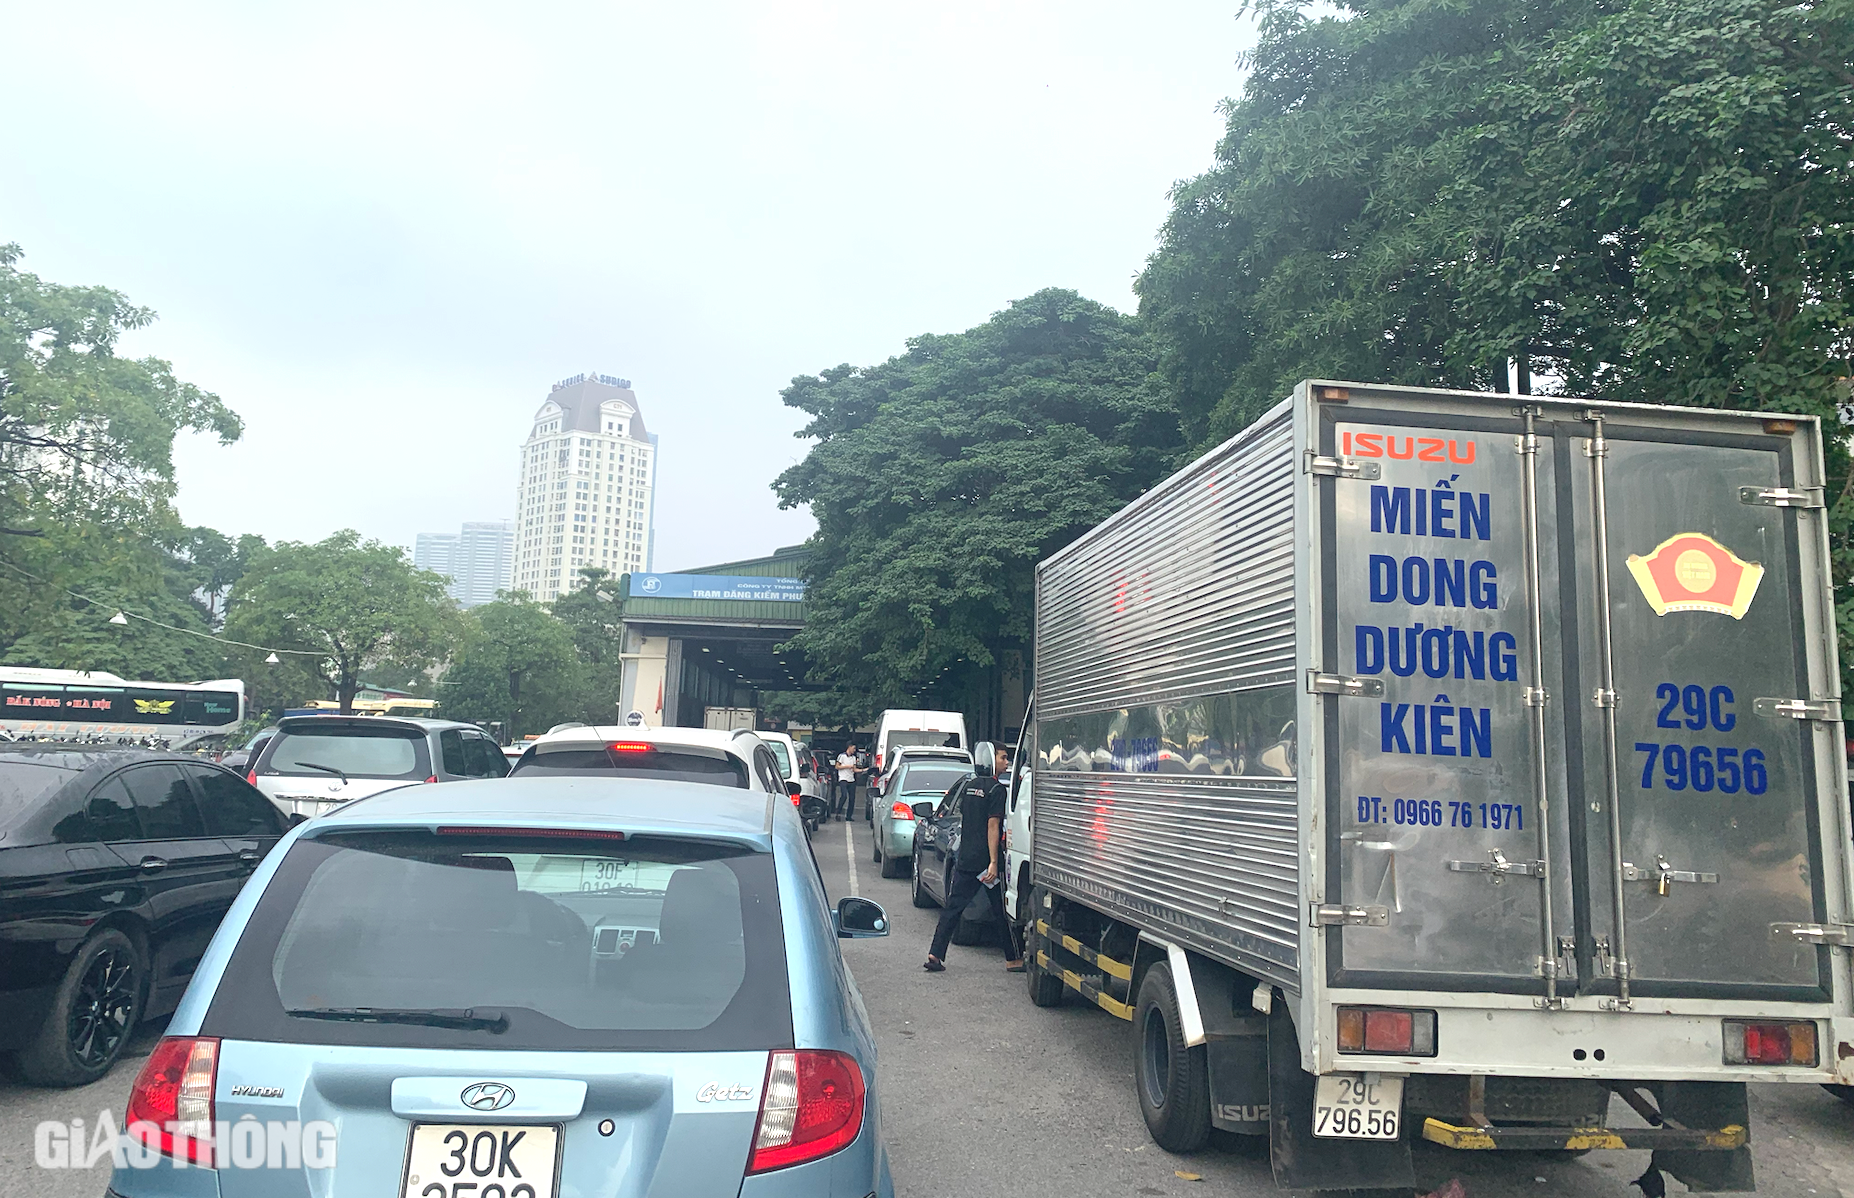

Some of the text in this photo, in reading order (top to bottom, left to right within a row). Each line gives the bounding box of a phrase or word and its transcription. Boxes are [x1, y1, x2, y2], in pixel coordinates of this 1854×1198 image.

[1343, 432, 1476, 464] ISUZU
[1371, 474, 1490, 540] MIẾN
[692, 590, 721, 599] TRẠM
[754, 589, 780, 600] KIỂM
[1370, 555, 1497, 609] DONG
[1355, 623, 1517, 681] DƯƠNG
[1381, 694, 1491, 758] KIÊN
[1657, 683, 1736, 731] 29C
[1635, 742, 1767, 795] 79656
[1358, 797, 1523, 830] ĐT: 0966 76 1971
[231, 1085, 284, 1098] HYUNDAI
[696, 1081, 754, 1103] Getz
[1336, 1079, 1380, 1105] 29C
[1317, 1107, 1396, 1136] 796.56
[440, 1130, 526, 1178] 30K
